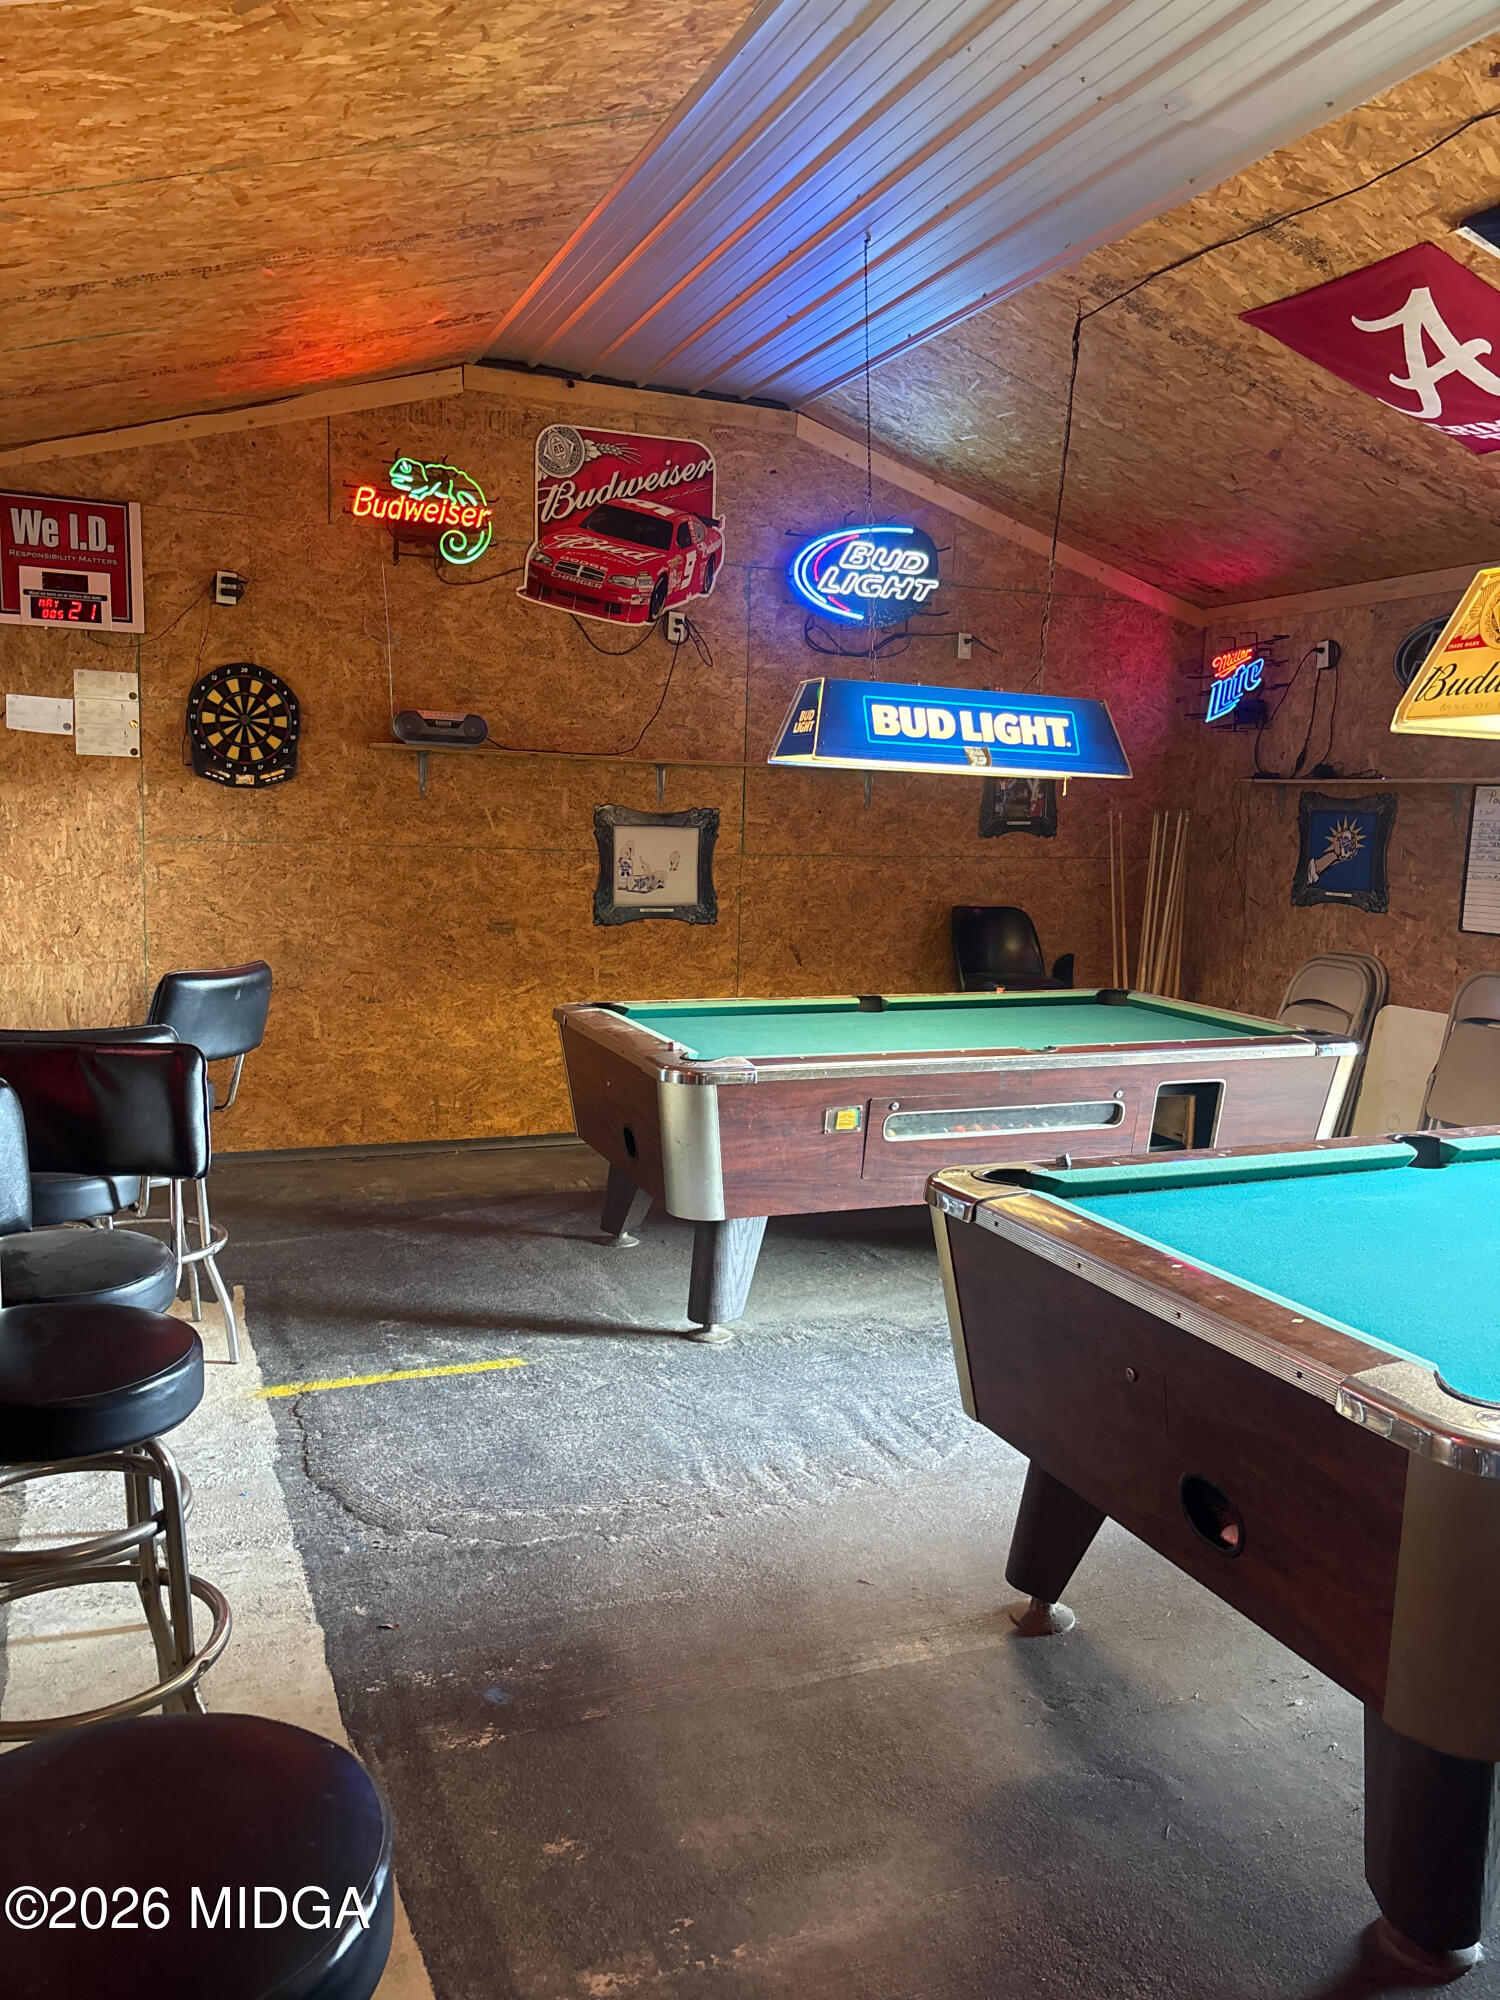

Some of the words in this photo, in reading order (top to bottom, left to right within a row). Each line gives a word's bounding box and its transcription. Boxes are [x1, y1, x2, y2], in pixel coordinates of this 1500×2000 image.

[352, 486, 493, 528] Budweiser
[537, 458, 714, 523] Budweiser
[10, 507, 59, 548] We
[69, 513, 115, 553] I.D.
[553, 533, 660, 561] Bud
[560, 555, 609, 572] DODGE
[680, 550, 698, 591] 9
[839, 541, 929, 575] BUD
[551, 571, 604, 589] CHARGER
[817, 566, 939, 602] LIGHT
[68, 601, 97, 621] 21
[1212, 648, 1252, 675] Miller
[1205, 657, 1264, 722] Lite
[793, 720, 815, 733] LIGHT
[799, 709, 815, 721] BUD
[871, 704, 956, 740] BUD
